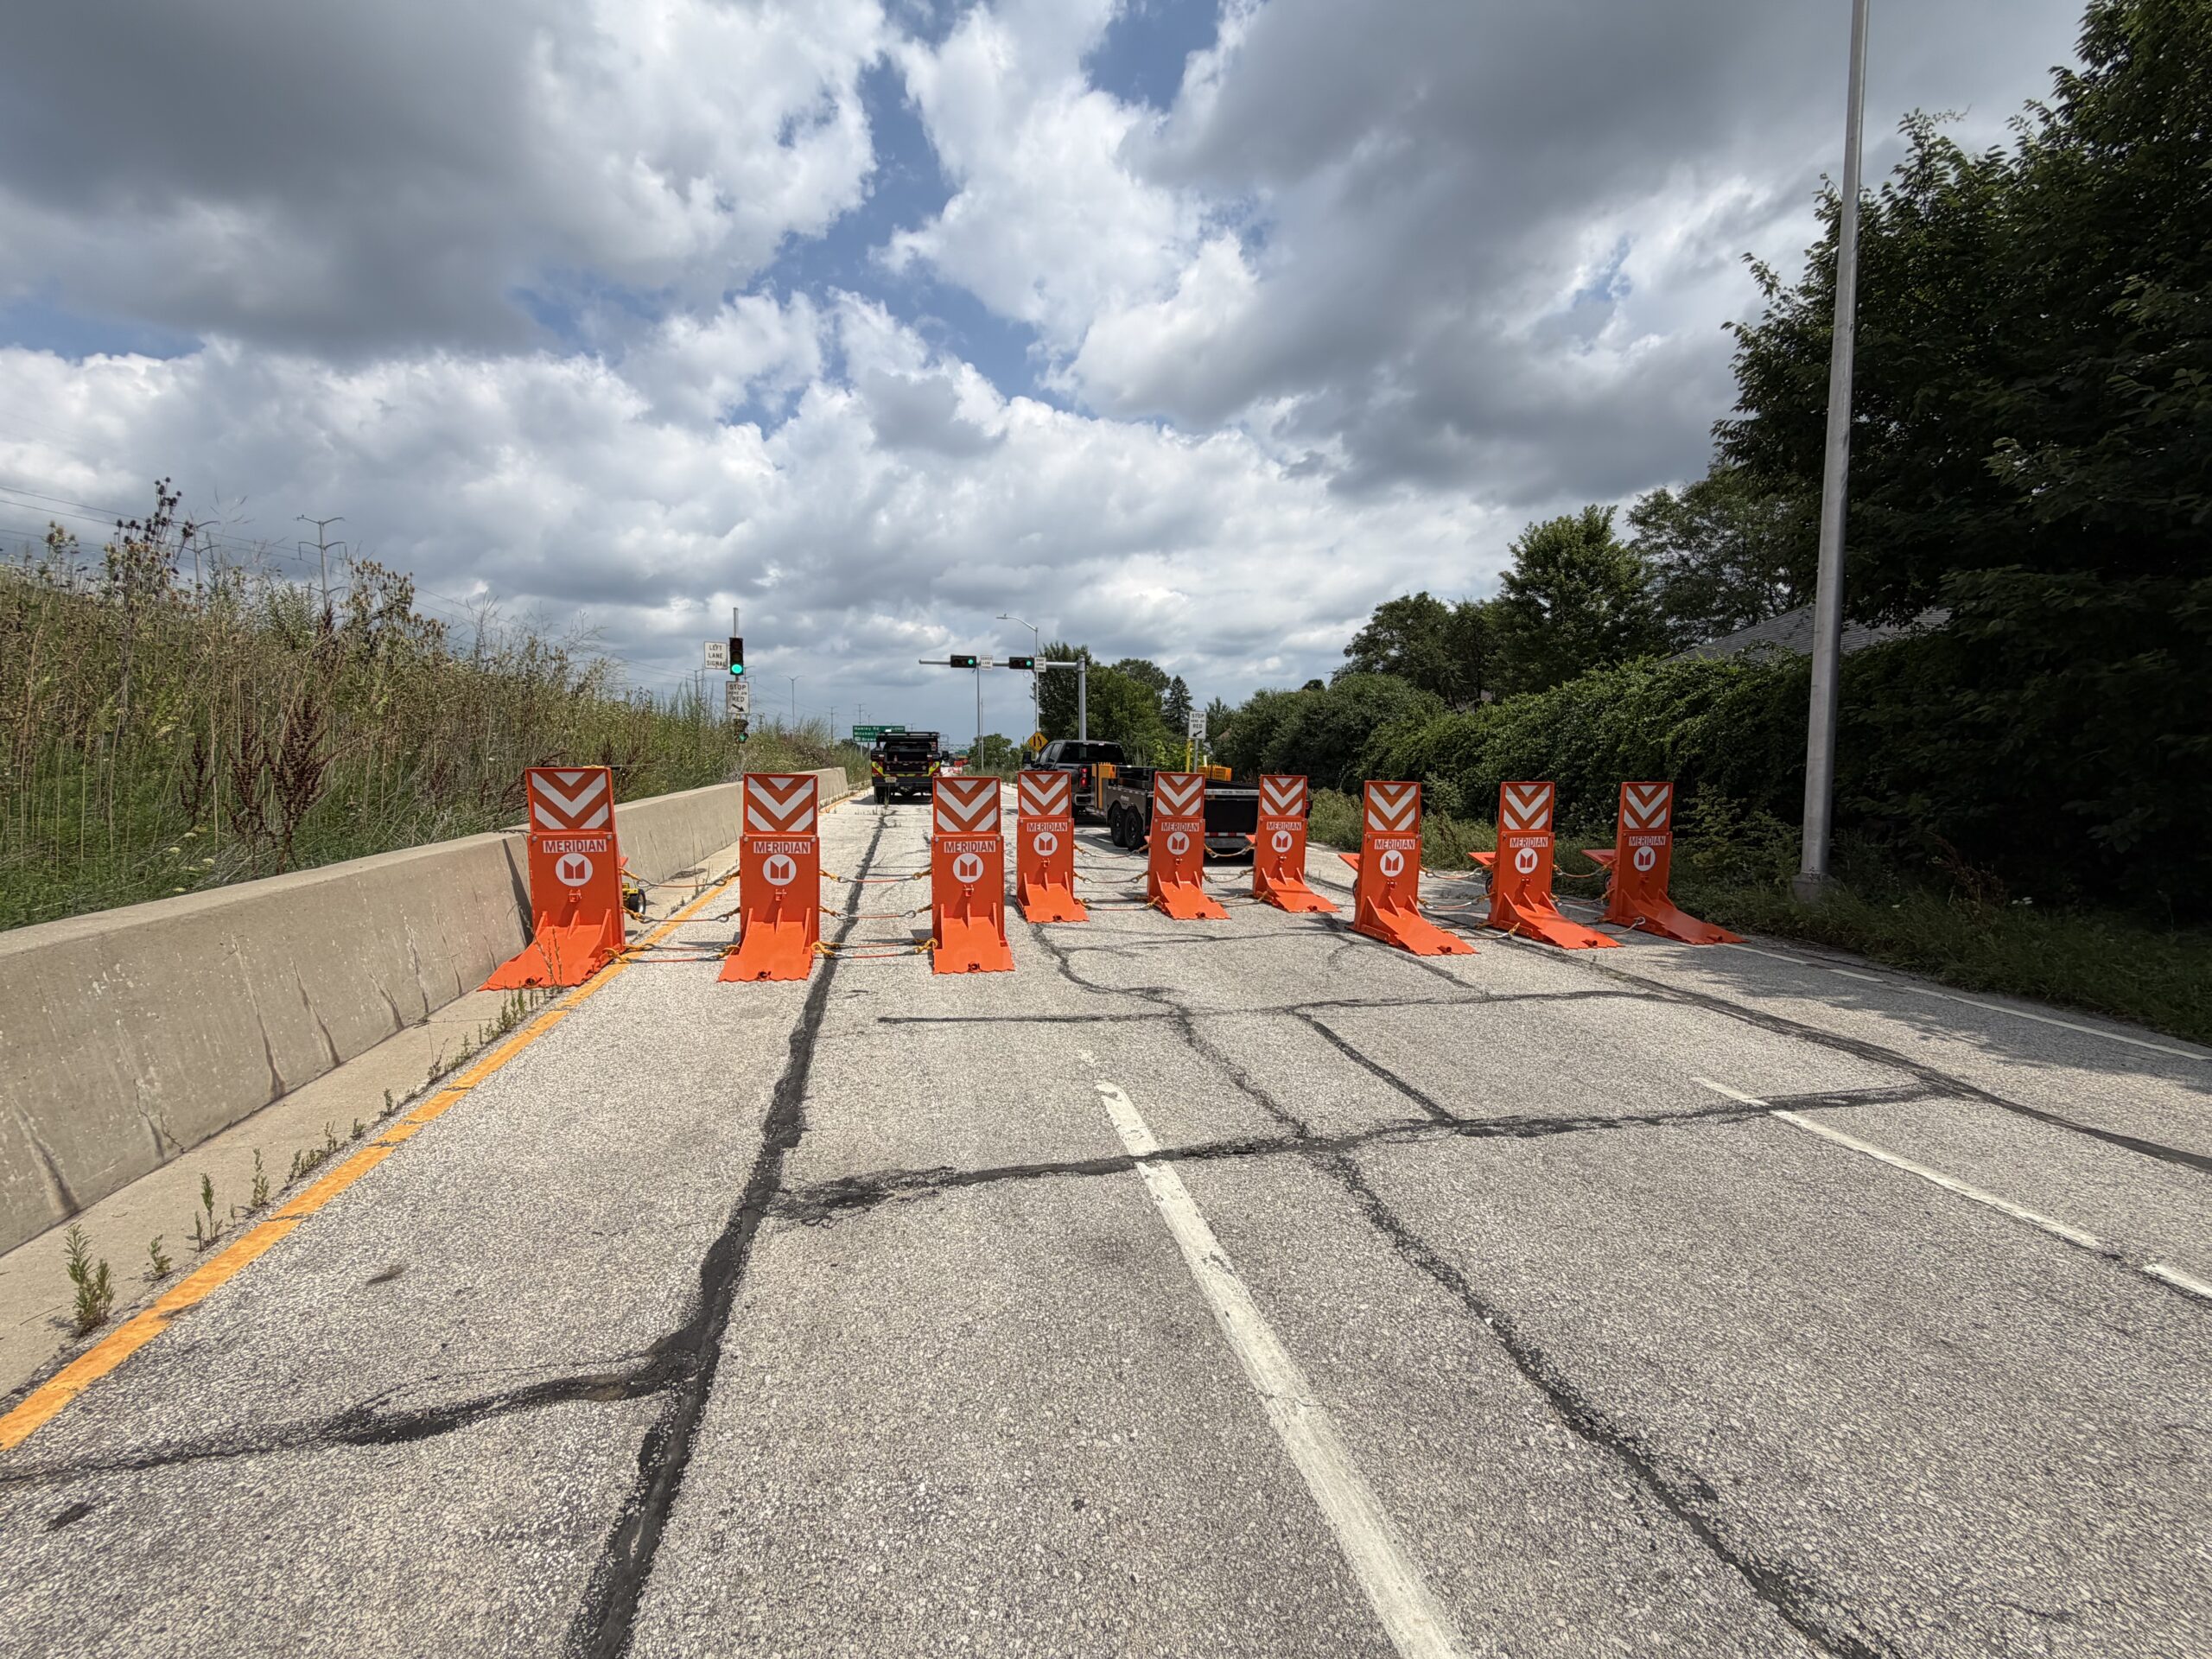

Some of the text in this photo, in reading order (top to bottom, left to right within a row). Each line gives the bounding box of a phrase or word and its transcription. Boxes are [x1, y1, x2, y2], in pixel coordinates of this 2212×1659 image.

[1028, 823, 1066, 831] MERIDIAN
[1162, 823, 1198, 831] MERIDIAN
[545, 840, 605, 852] MERIDIAN
[1376, 839, 1414, 849] MERIDIAN
[1510, 837, 1547, 848] MERIDIAN
[1630, 836, 1665, 846] MERIDIAN
[755, 842, 809, 854] MERIDIAN
[945, 842, 995, 853] MERIDIAN
